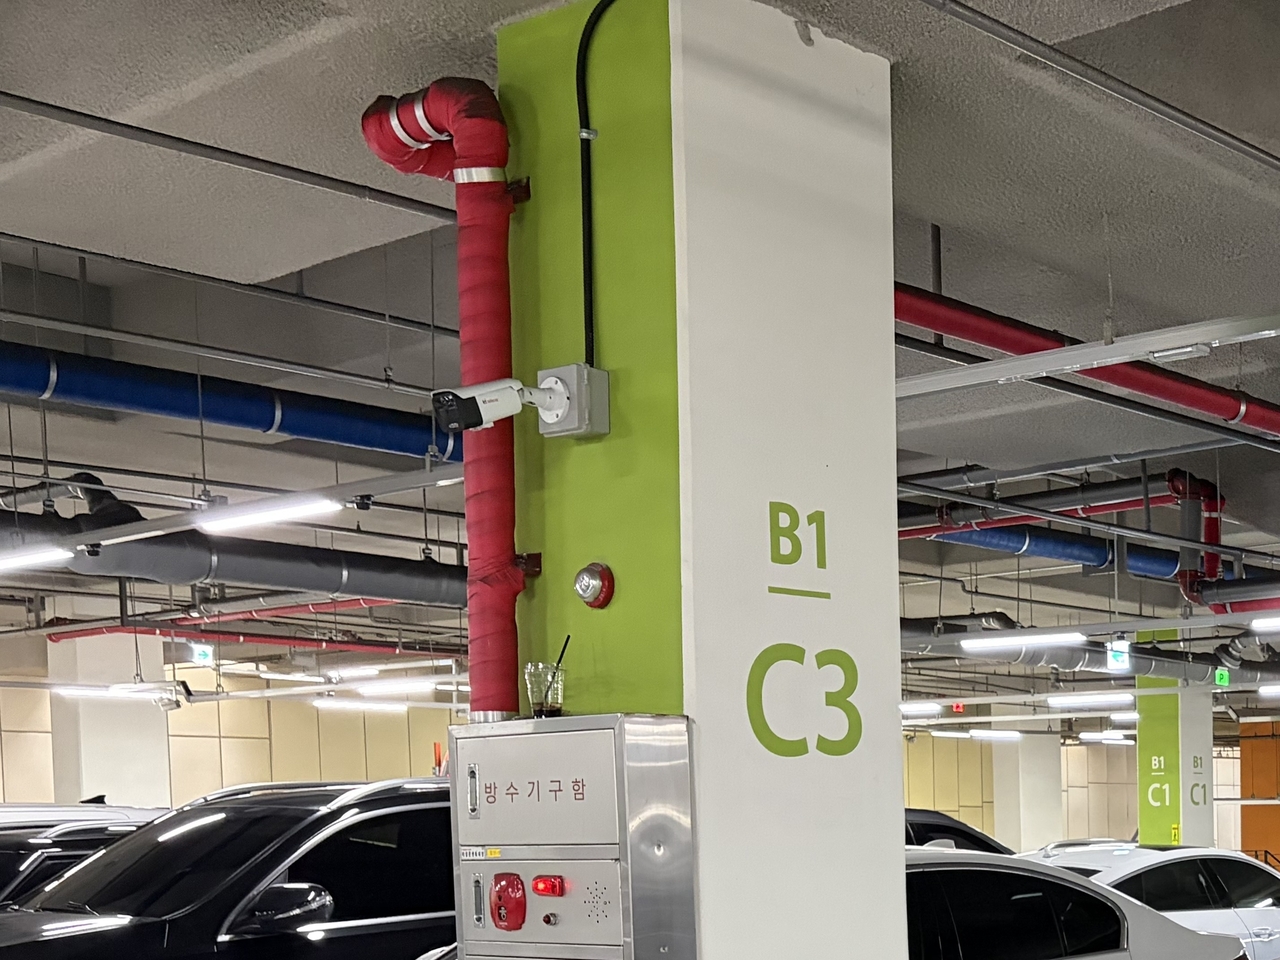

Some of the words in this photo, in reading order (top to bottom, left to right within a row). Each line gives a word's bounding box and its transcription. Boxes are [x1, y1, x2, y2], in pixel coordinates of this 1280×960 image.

[769, 501, 826, 569] B1
[746, 643, 862, 757] C3
[1151, 756, 1165, 770] B1
[1193, 756, 1203, 769] B1
[1147, 783, 1170, 807] C1
[1190, 783, 1207, 806] C1
